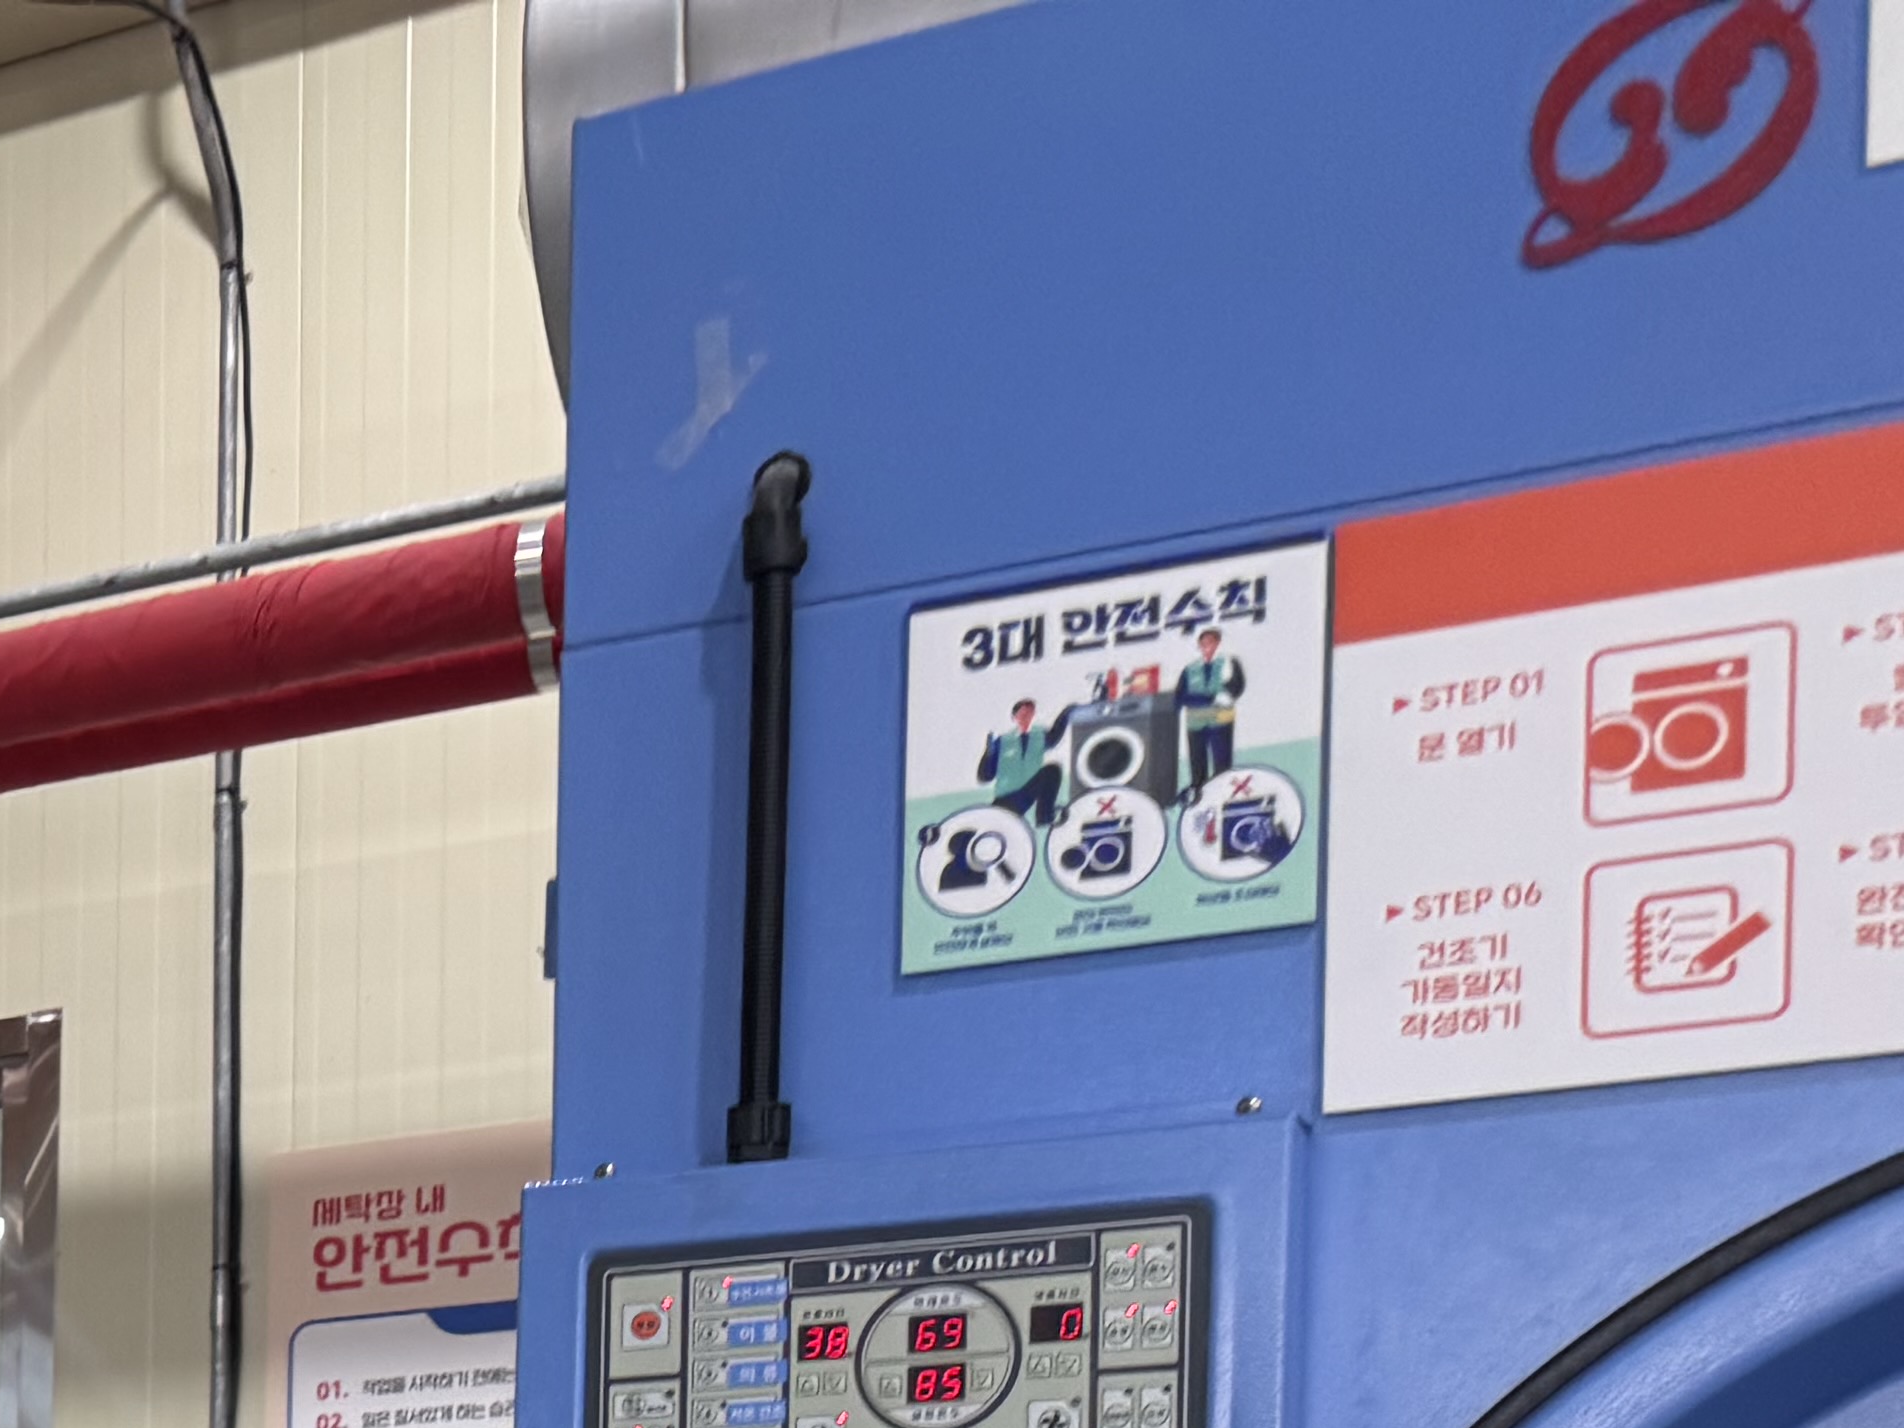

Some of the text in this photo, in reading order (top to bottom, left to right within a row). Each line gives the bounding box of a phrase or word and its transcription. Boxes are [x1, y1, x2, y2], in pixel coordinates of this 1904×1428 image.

[960, 576, 1268, 673] 3대 안전수칙
[1418, 667, 1546, 713] STEP 01
[1456, 720, 1517, 758] 열기
[1412, 880, 1543, 923] STEP 06
[1417, 931, 1509, 971] 건조기
[1400, 1000, 1523, 1041] 작성하기
[312, 1183, 445, 1227] 세탁장 내
[827, 1239, 1058, 1285] Dryer Control
[803, 1326, 850, 1361] 38
[914, 1317, 964, 1352] 69
[316, 1380, 349, 1400] 01.
[914, 1365, 963, 1402] 85
